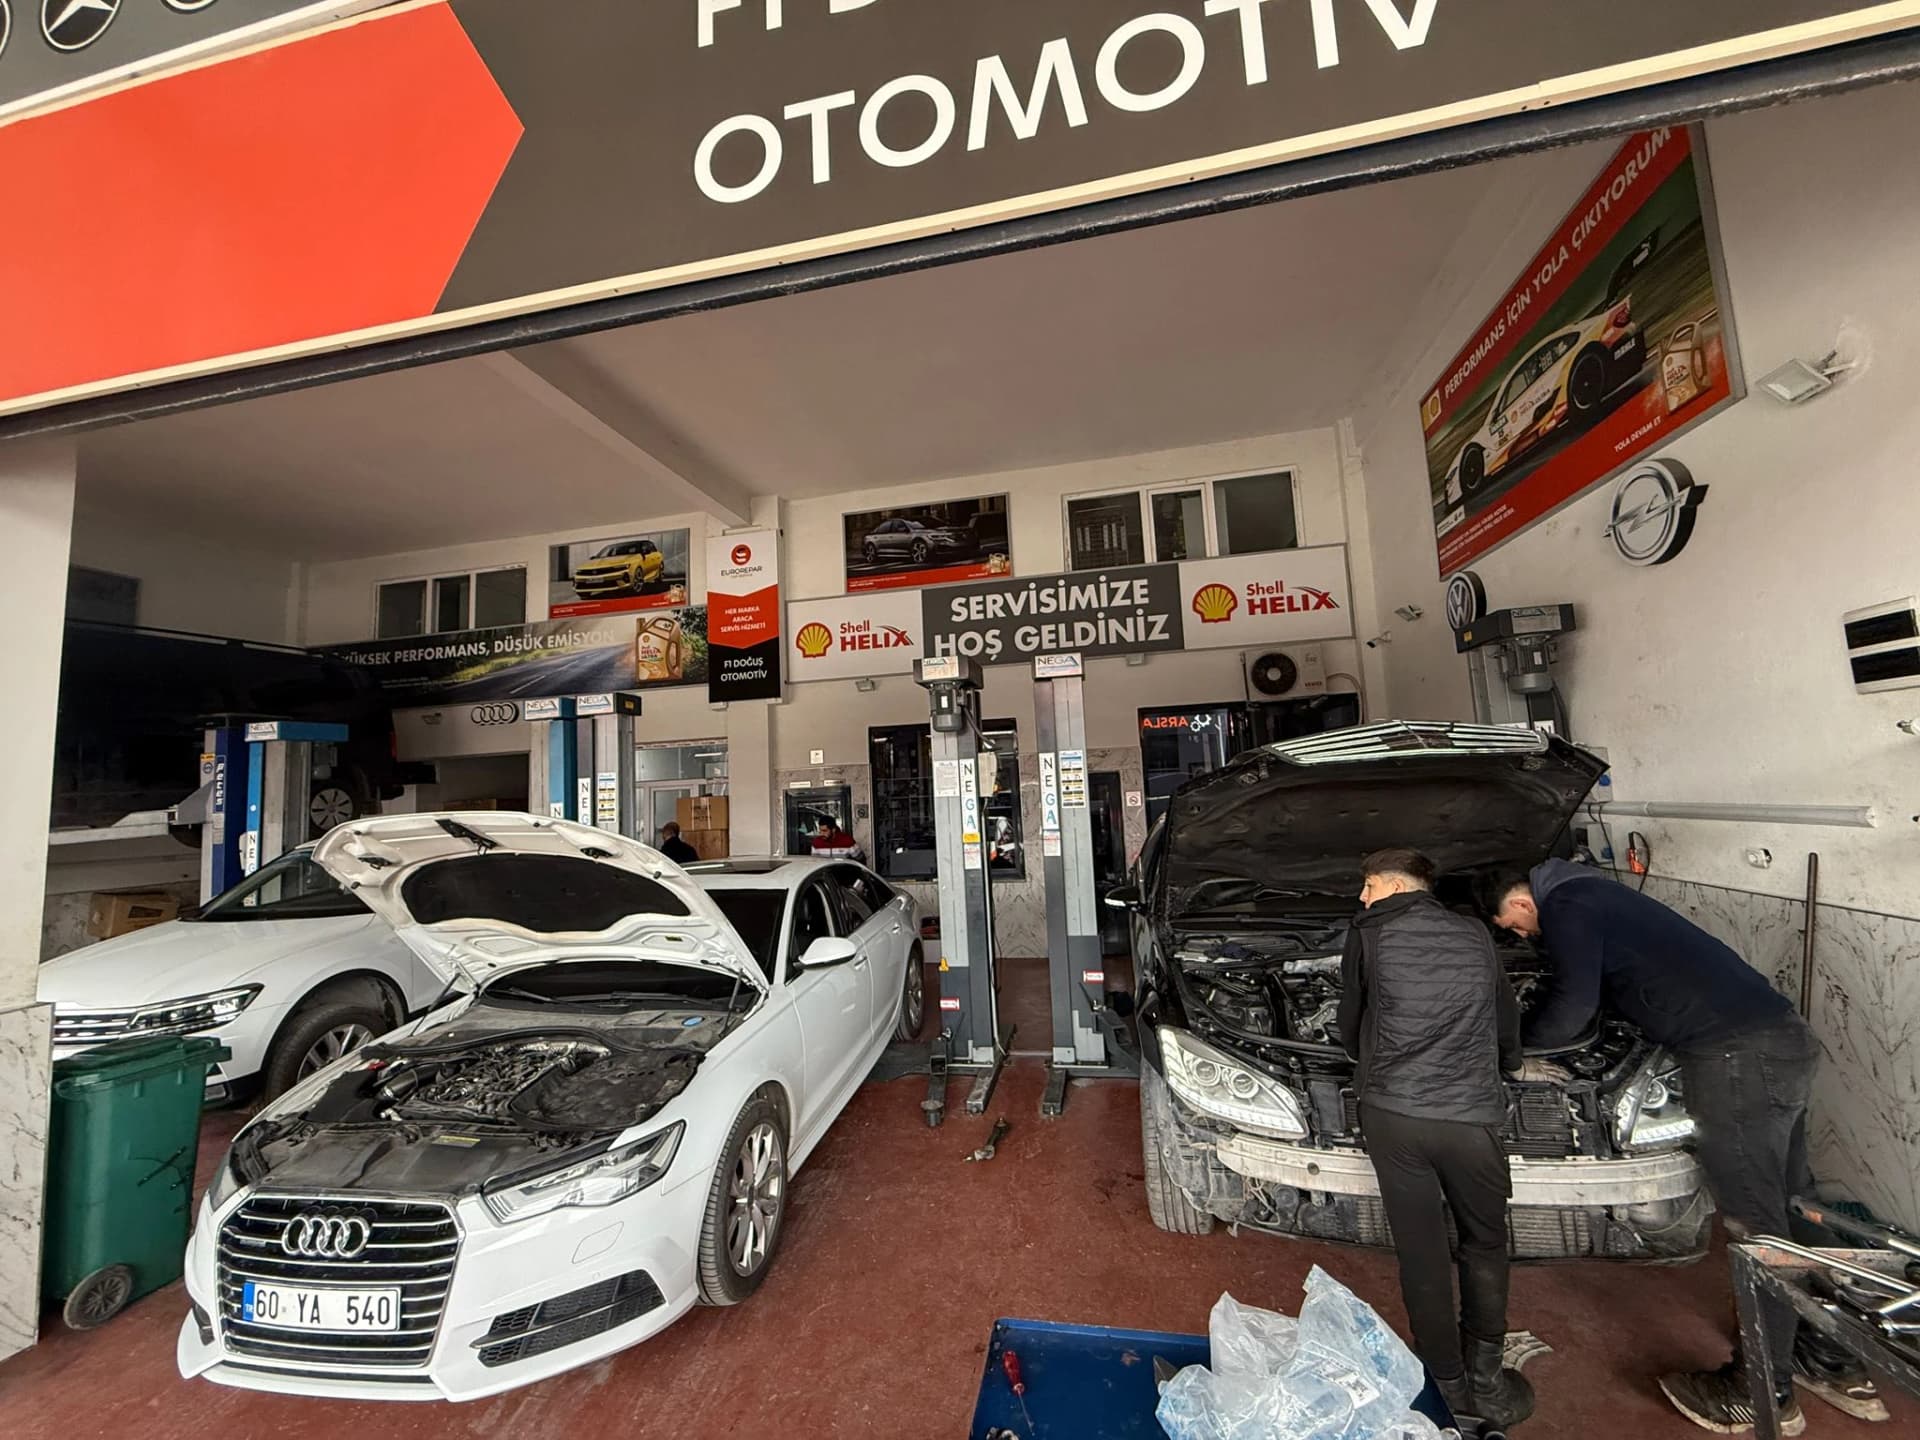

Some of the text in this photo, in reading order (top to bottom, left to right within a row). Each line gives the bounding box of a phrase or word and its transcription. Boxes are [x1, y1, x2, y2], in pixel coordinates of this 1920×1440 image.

[1444, 319, 1506, 399] PERFORMANS
[1506, 286, 1532, 327] İÇİN
[1532, 245, 1569, 293] YOLA
[1571, 127, 1671, 251] ÇIKIYORUM
[720, 566, 762, 577] EUROREPAR
[951, 575, 1149, 622] SERVİSİMİZE
[1246, 580, 1284, 596] Shell
[725, 605, 760, 615] HER MARKA
[1246, 591, 1338, 616] HELIX
[720, 624, 740, 633] SERVİS
[732, 615, 753, 623] ARACA
[839, 620, 870, 634] Shell
[394, 641, 490, 664] PERFORMANS,
[494, 636, 543, 655] DÜŞÜK
[547, 629, 616, 649] EMİSYON
[839, 629, 913, 652] HELIX
[934, 608, 1170, 661] HOŞ GELDİNİZ
[1037, 655, 1080, 668] NEGA
[720, 668, 768, 682] OTOMOTİV
[963, 763, 977, 830] NEGA
[1043, 756, 1057, 825] NEGA
[581, 782, 590, 825] NEG
[248, 834, 259, 874] NEG
[256, 1289, 390, 1326] 60 YA 540
